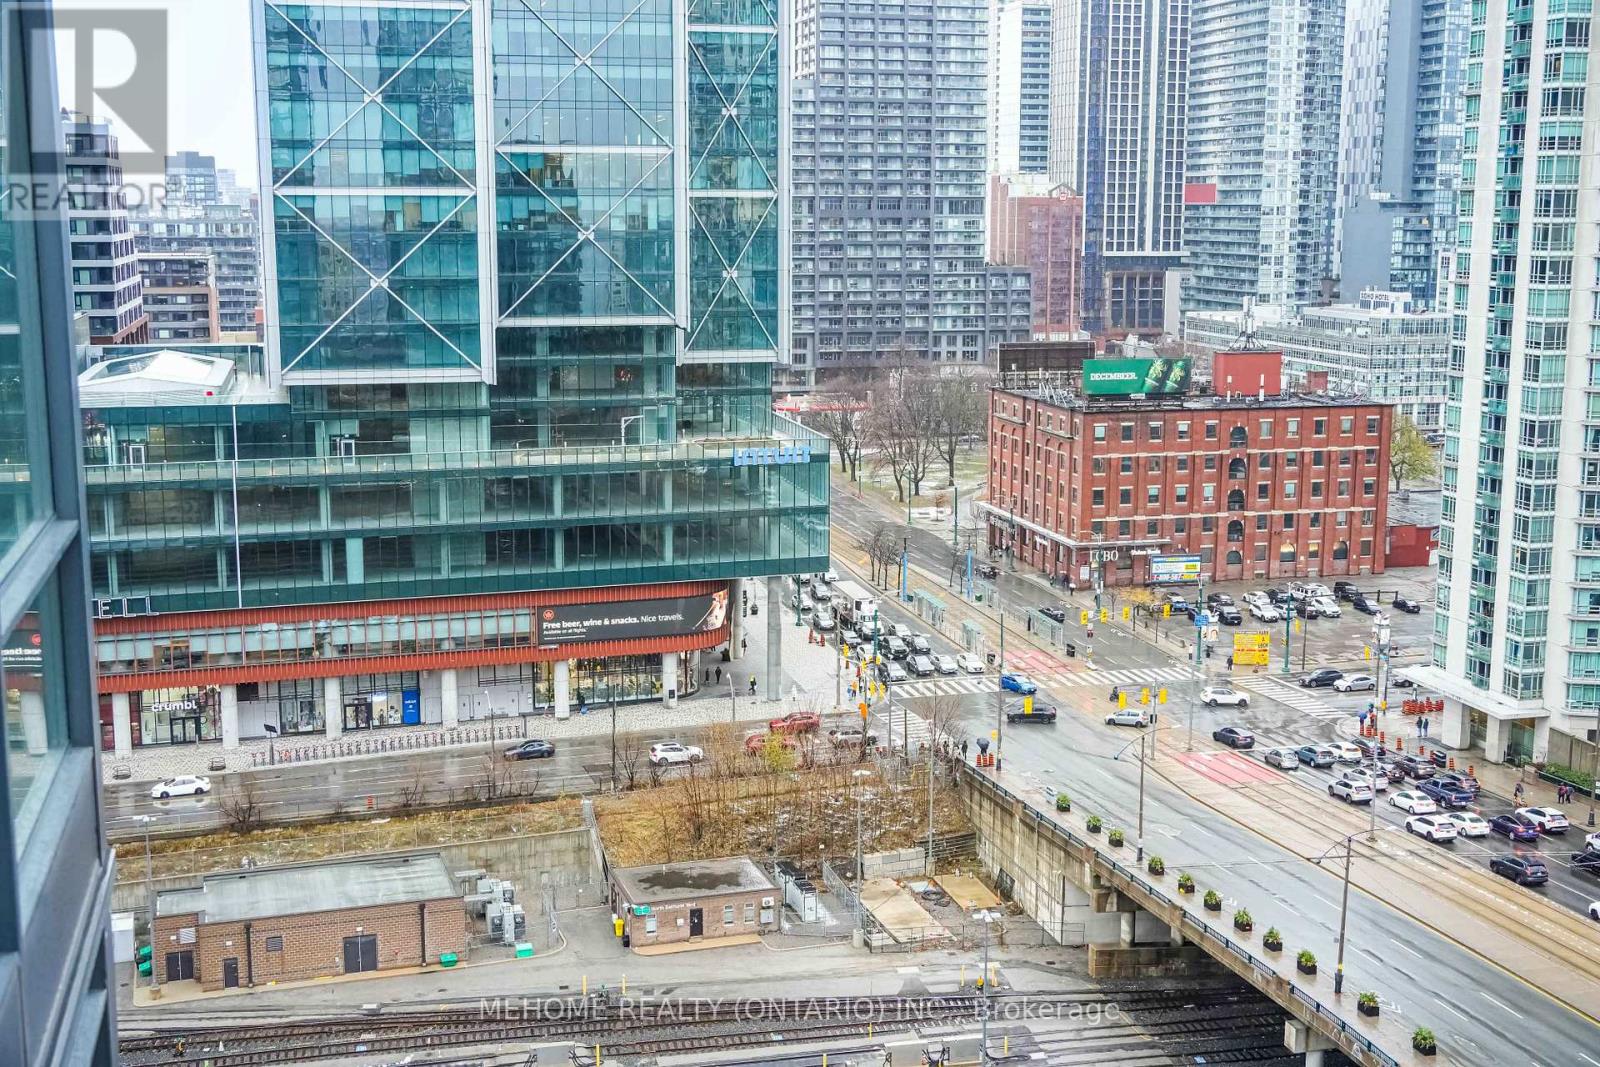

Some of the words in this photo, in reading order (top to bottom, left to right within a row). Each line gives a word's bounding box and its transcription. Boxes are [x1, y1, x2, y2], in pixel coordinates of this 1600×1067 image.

[583, 618, 602, 626] wine
[603, 617, 610, 625] &
[640, 615, 657, 623] Nice
[151, 700, 198, 712] crumbl
